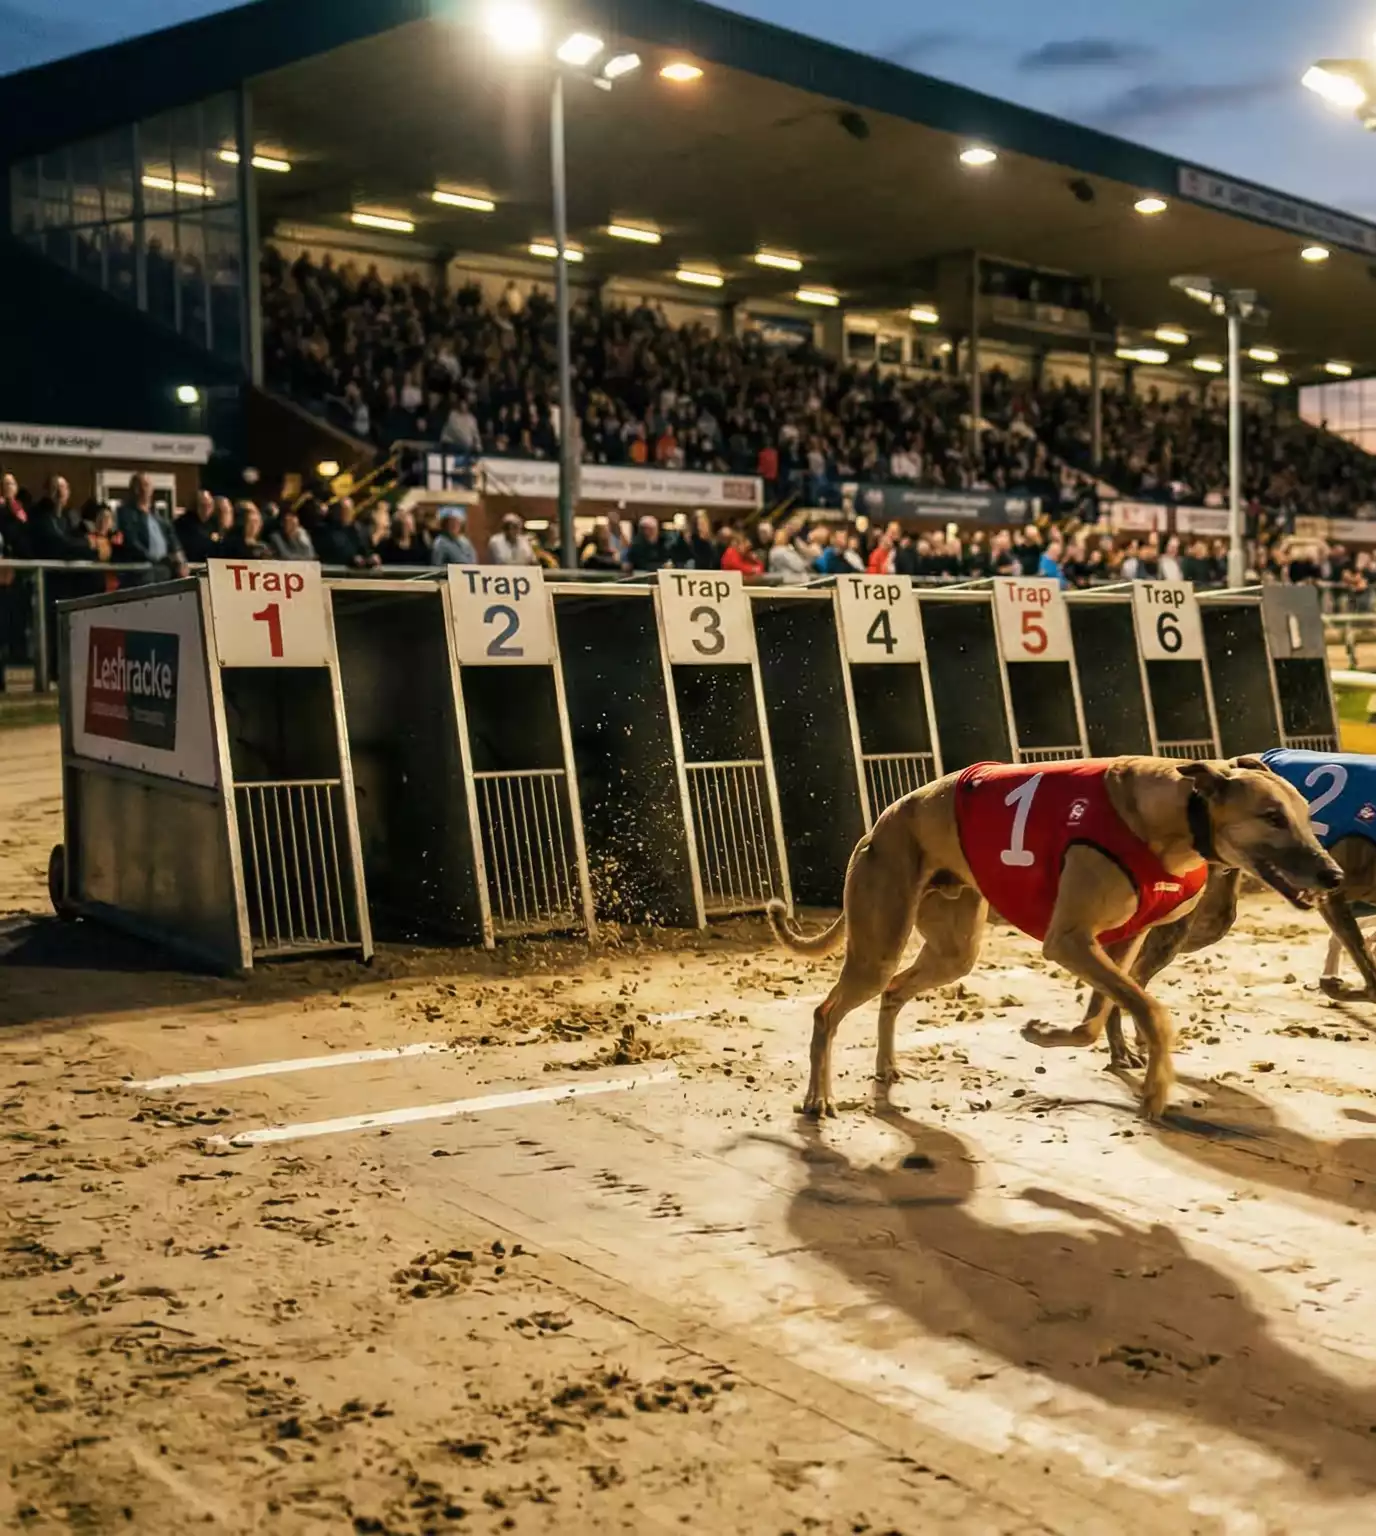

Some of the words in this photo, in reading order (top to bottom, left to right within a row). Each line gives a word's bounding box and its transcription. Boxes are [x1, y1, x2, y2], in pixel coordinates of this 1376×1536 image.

[226, 564, 304, 600] Trap
[462, 569, 530, 601] Trap
[671, 574, 730, 603] Trap
[848, 579, 901, 606] Trap
[1004, 581, 1052, 607] Trap
[1142, 584, 1185, 608] Trap
[252, 603, 284, 658] 1
[483, 604, 524, 657] 2
[689, 605, 725, 656] 3
[866, 609, 898, 654] 4
[1021, 611, 1048, 654] 5
[1156, 611, 1183, 653] 6
[93, 645, 172, 700] Leshracke
[1000, 772, 1045, 867] 1
[1304, 763, 1348, 837] 2
